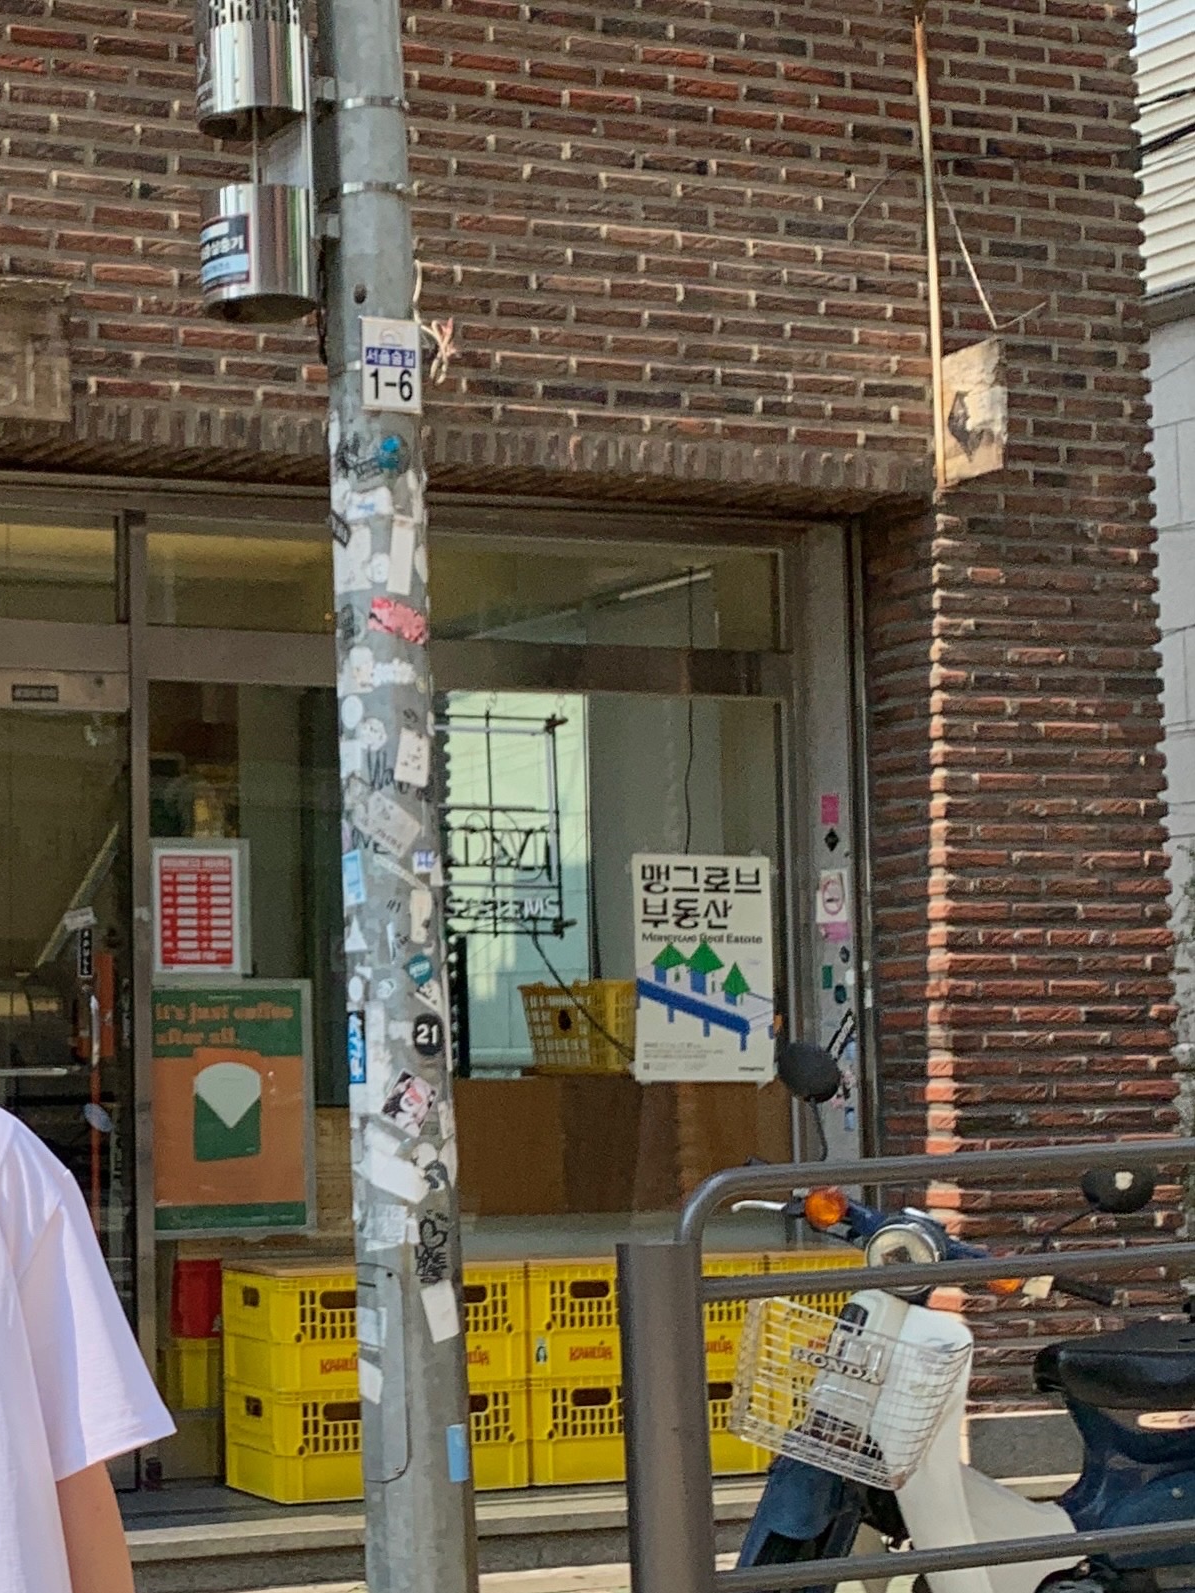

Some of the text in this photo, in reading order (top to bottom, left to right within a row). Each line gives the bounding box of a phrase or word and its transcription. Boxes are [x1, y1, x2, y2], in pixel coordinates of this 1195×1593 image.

[366, 348, 415, 367] 서울숲길
[370, 368, 413, 402] 1-6
[641, 864, 762, 894] 맹그로브
[641, 897, 733, 930] 부동산
[416, 1023, 439, 1045] 21
[790, 1346, 885, 1386] HONDA
